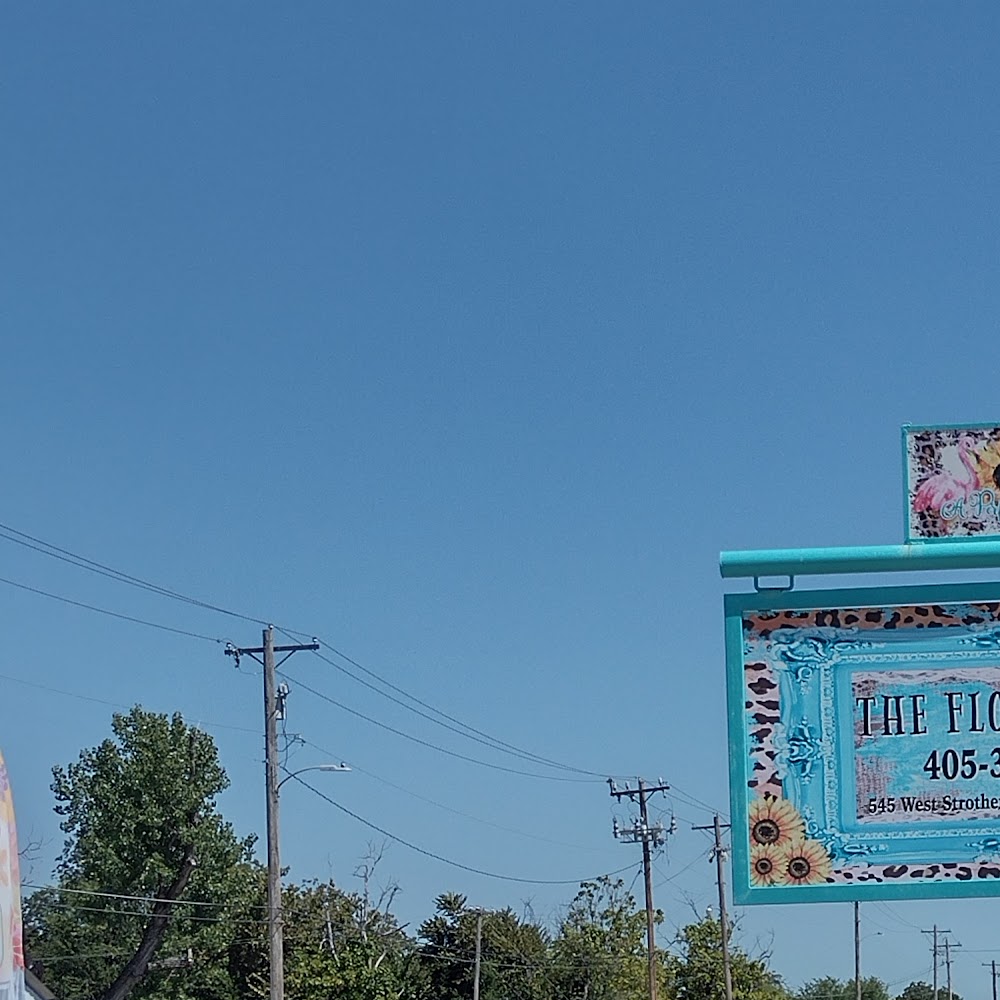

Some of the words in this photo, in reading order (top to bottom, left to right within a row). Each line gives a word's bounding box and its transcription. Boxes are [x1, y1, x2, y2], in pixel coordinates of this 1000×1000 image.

[856, 694, 928, 737] THE
[868, 797, 896, 814] 545
[900, 796, 937, 813] West
